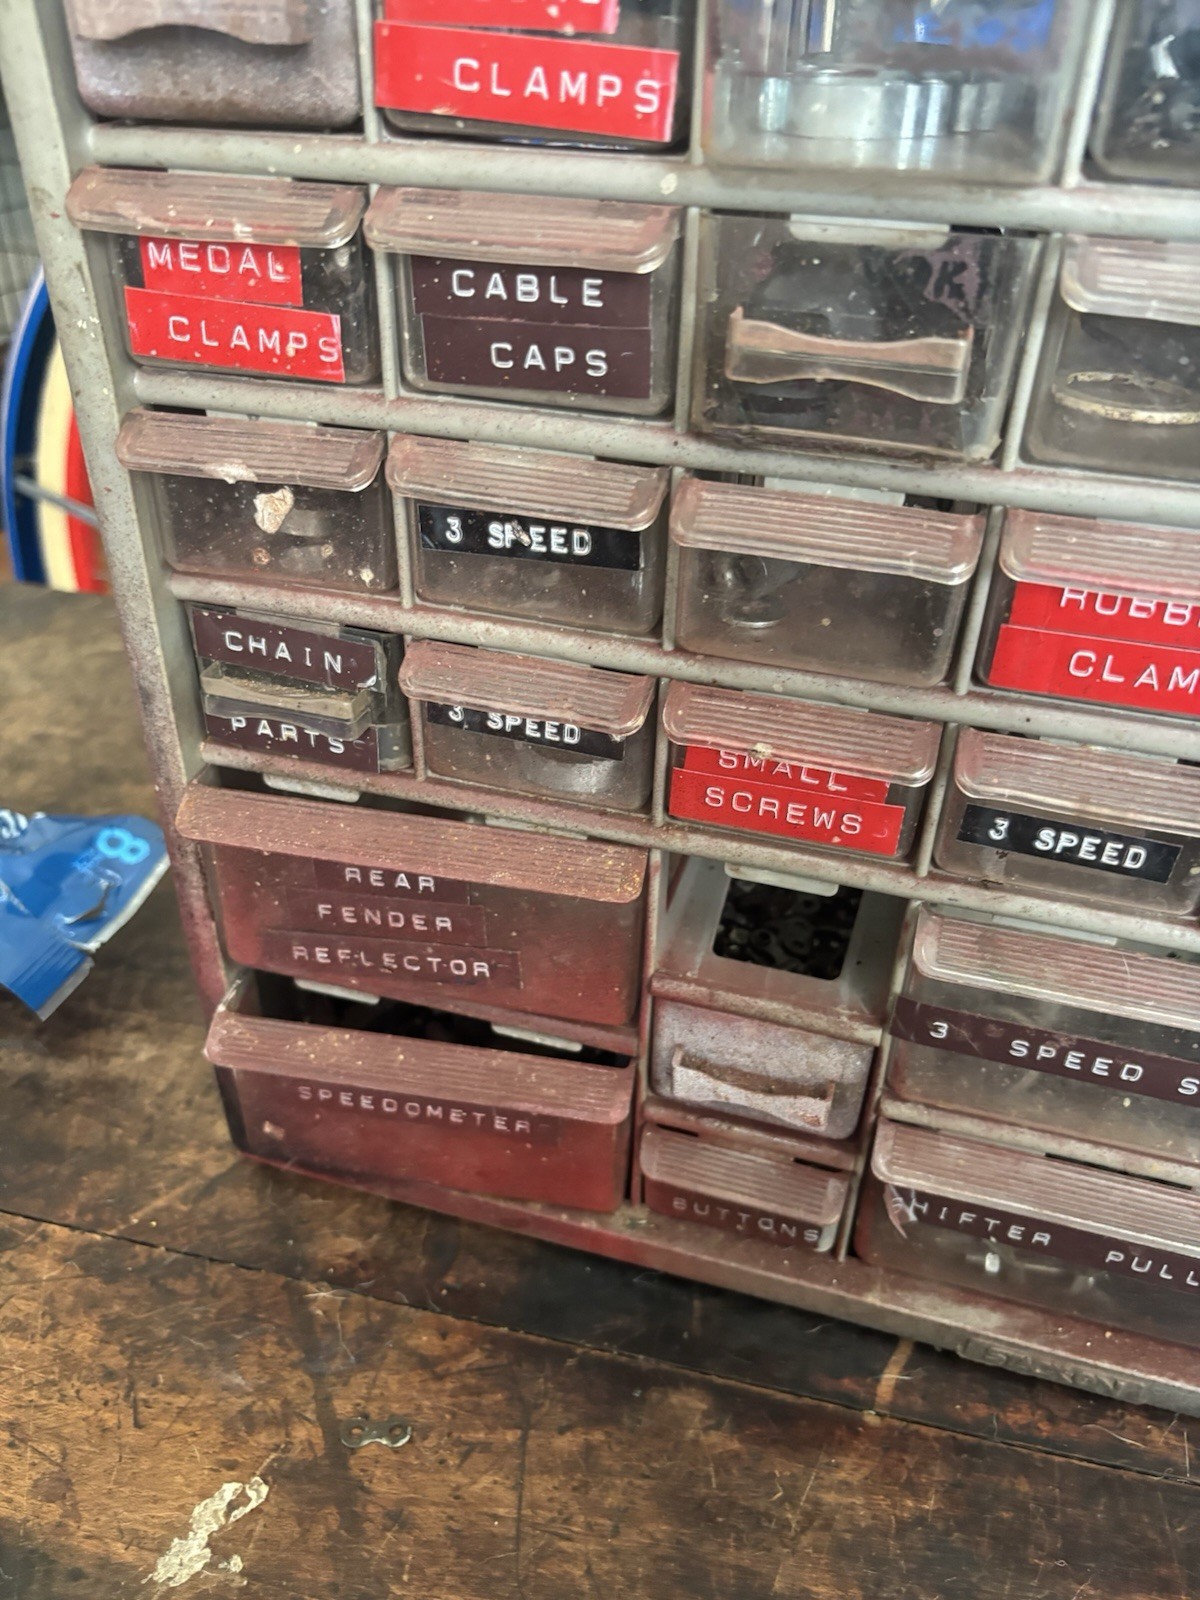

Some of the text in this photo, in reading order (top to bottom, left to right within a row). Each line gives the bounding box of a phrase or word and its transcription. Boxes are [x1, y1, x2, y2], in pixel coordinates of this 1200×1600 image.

[453, 58, 661, 113] CLAMPS
[147, 242, 290, 282] MEDAL
[452, 269, 604, 307] CABLE
[168, 315, 339, 363] CLAMPS
[490, 342, 608, 377] CAPS
[444, 516, 463, 543] 3
[1060, 586, 1200, 629] RUBB
[224, 631, 342, 674] CHAIN
[230, 716, 345, 754] PARTS
[487, 711, 581, 744] SPEED
[718, 750, 847, 791] SMALL
[704, 786, 863, 835] SCREWS
[987, 816, 1148, 870] 3 SPEED
[345, 867, 435, 892] REAR
[317, 904, 452, 932] FENDER
[291, 946, 490, 978] REFLECTOR
[929, 1021, 948, 1039] 3
[1009, 1039, 1143, 1082] SPEED
[298, 1086, 531, 1133] SPEEDOMETER
[672, 1197, 819, 1242] BUTTONS
